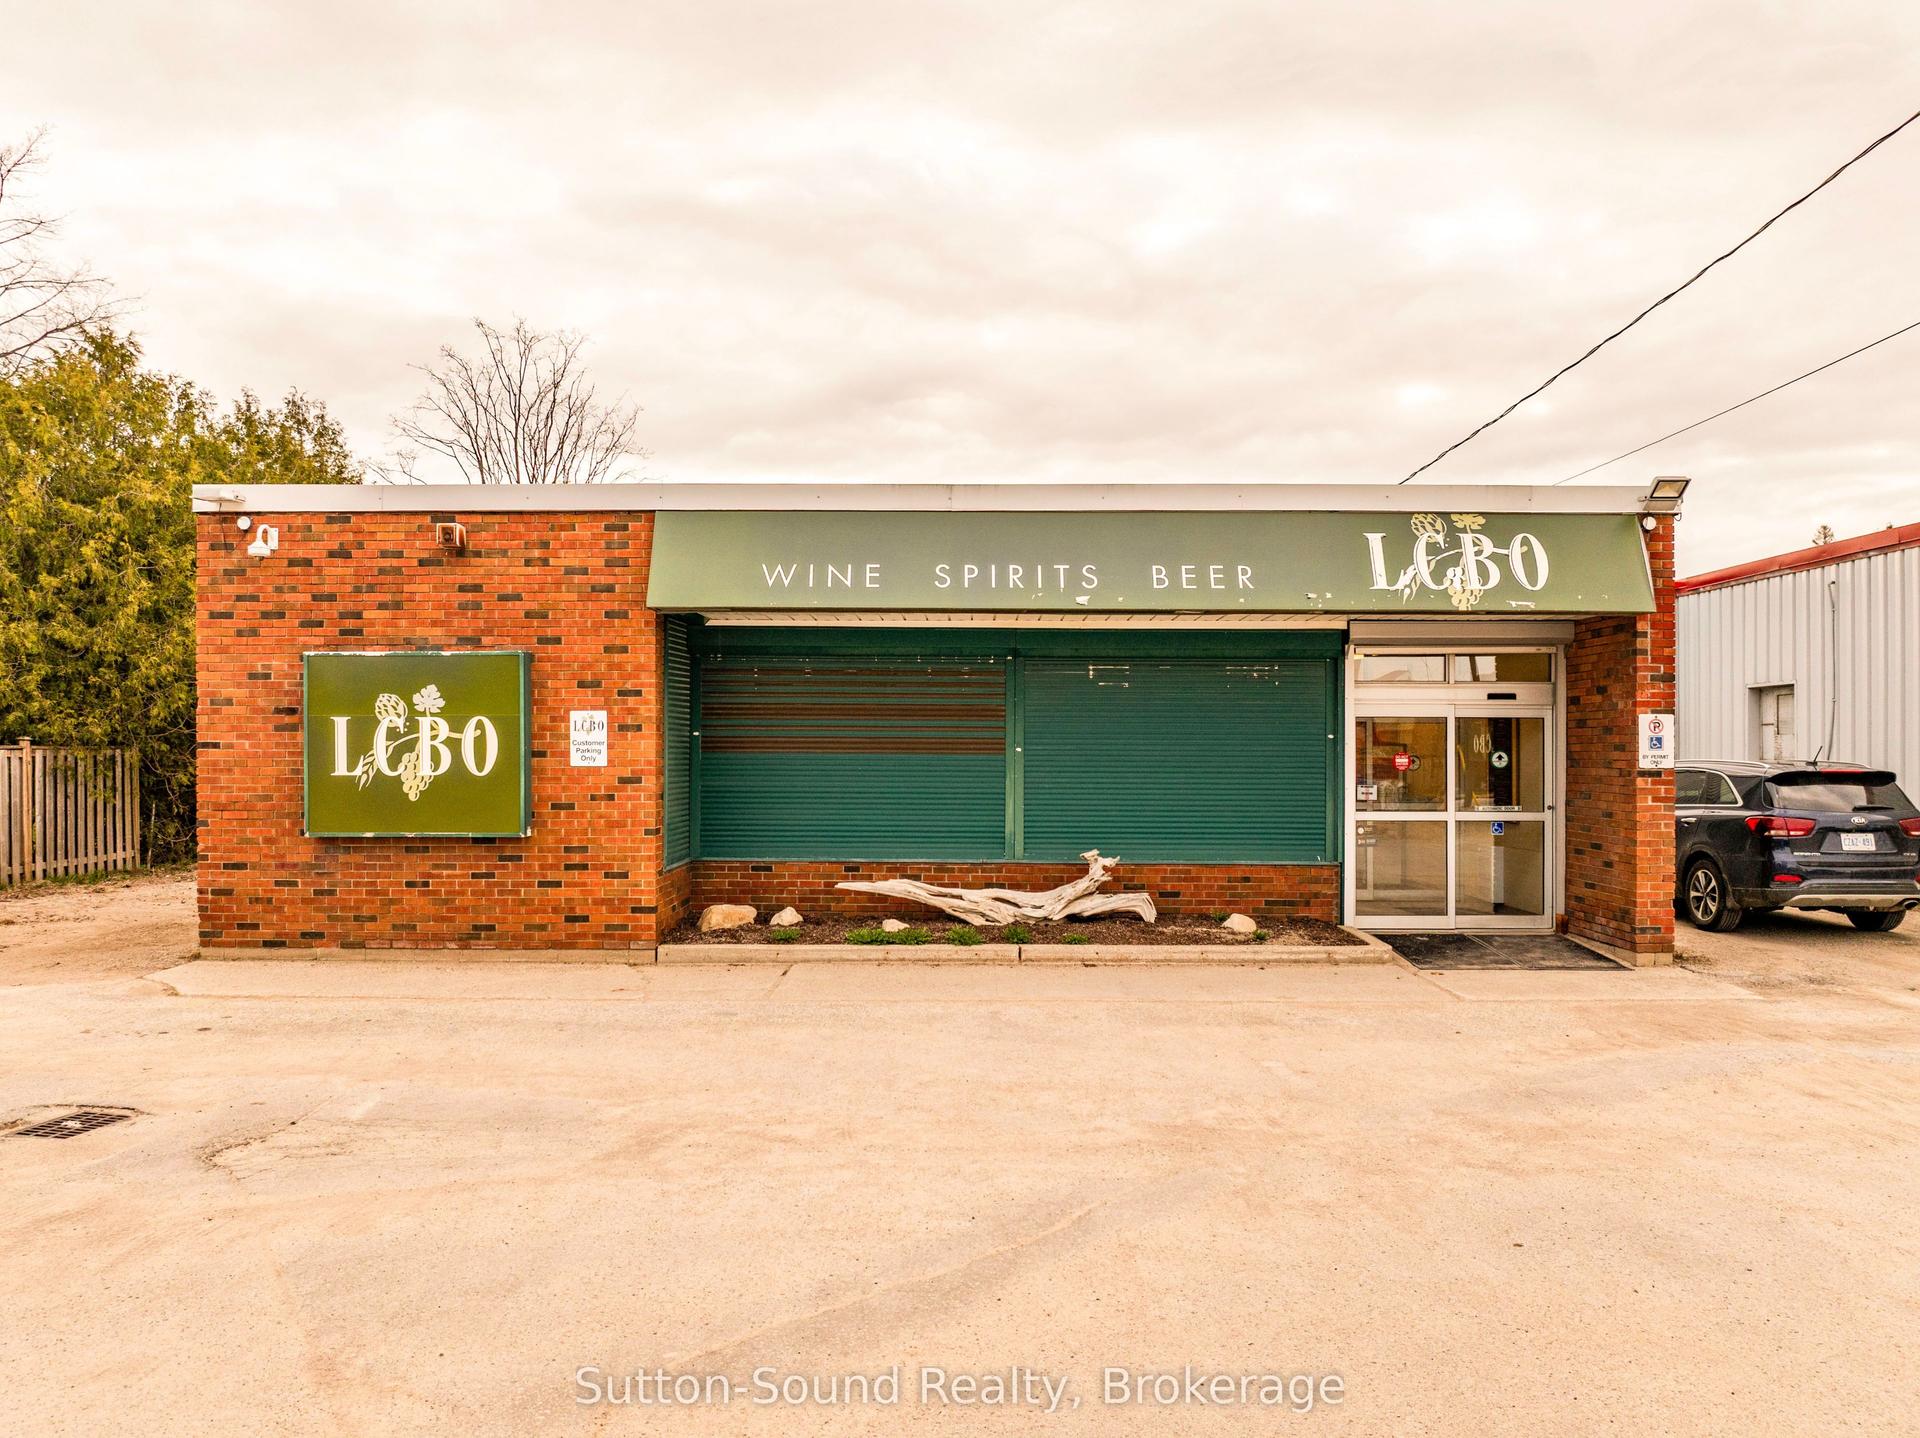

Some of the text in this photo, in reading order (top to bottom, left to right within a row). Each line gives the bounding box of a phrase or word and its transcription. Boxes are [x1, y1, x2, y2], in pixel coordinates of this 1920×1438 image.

[1363, 532, 1549, 591] LCBO
[761, 563, 1256, 590] WINE SPIRITS BEER
[573, 720, 605, 732] LCBO
[330, 715, 499, 777] LCBO
[575, 747, 602, 755] Parking
[580, 754, 597, 762] Only
